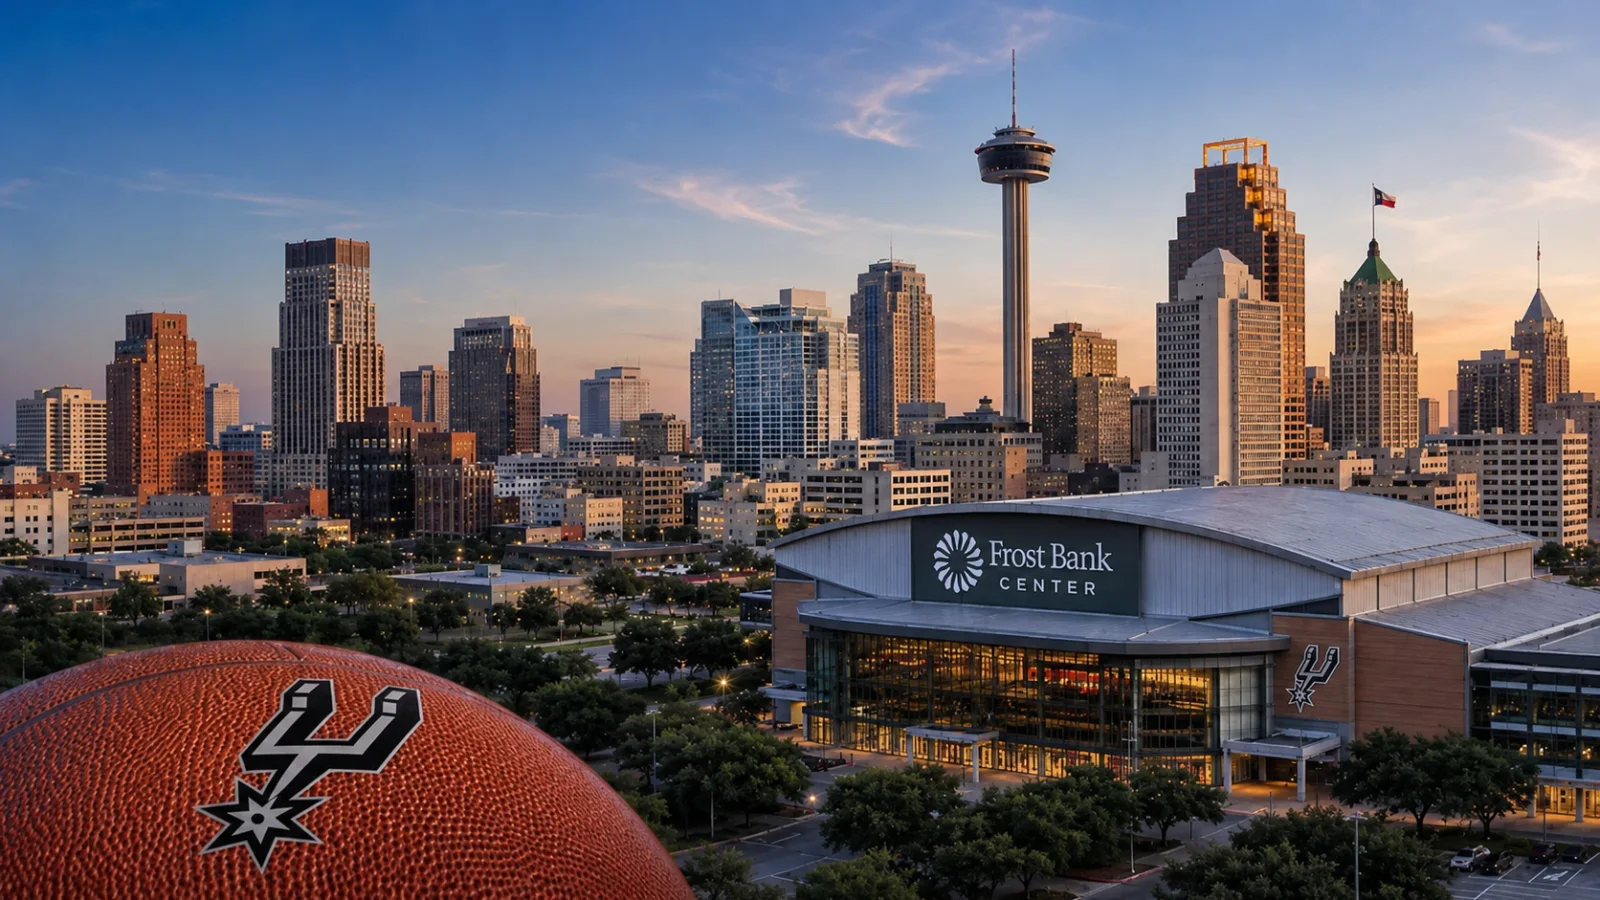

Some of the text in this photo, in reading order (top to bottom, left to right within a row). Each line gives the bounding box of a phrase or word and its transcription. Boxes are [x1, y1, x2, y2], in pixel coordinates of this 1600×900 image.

[989, 540, 1114, 572] Frost Bank
[1000, 577, 1095, 596] CENTER
